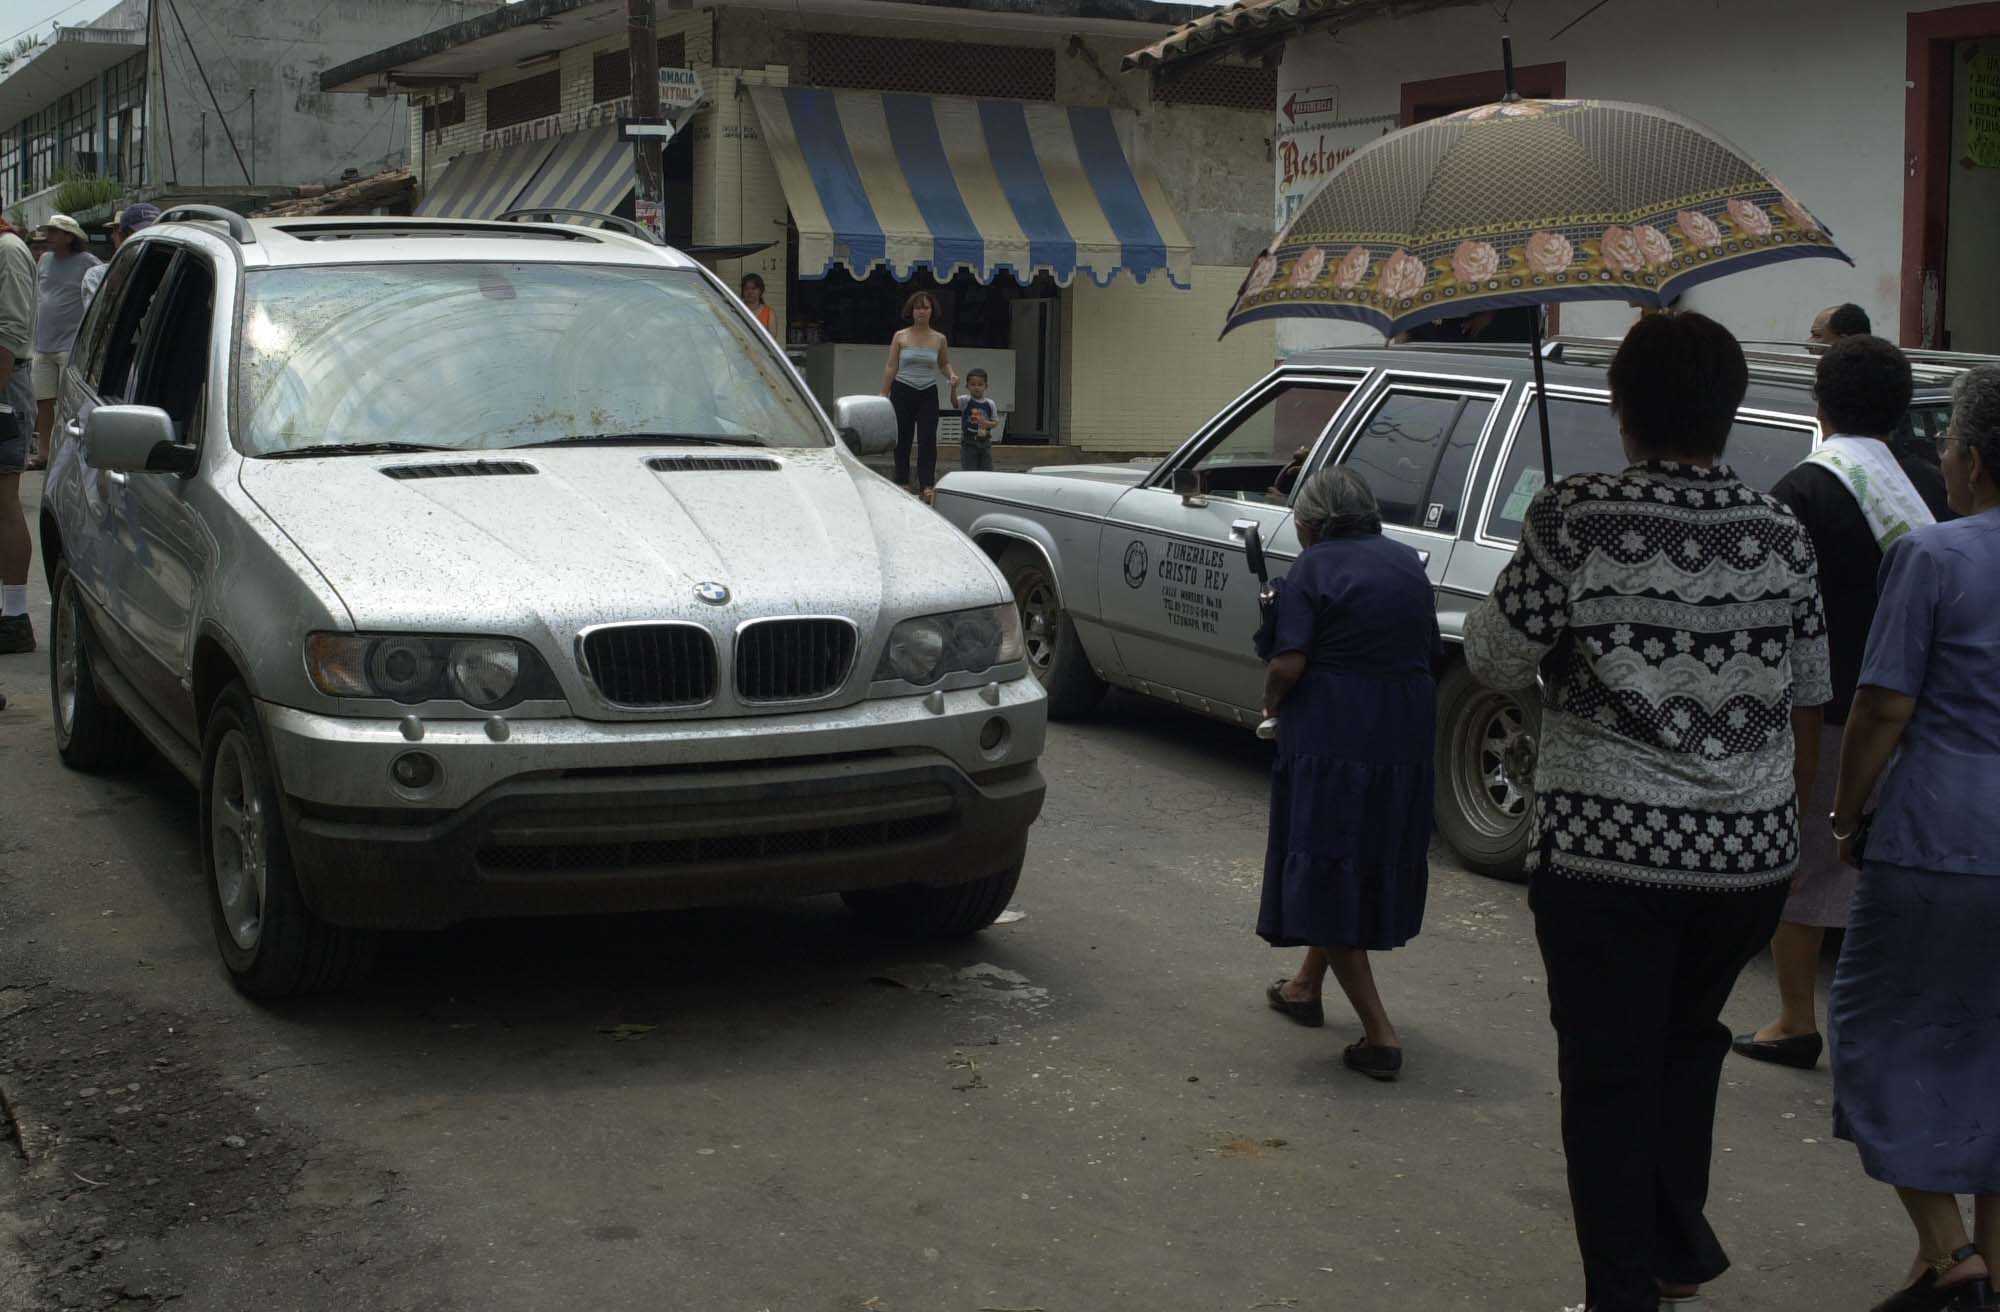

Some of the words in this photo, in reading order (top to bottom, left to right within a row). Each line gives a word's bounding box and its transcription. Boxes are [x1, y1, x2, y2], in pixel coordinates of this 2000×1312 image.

[656, 70, 695, 85] ARMACIA
[1166, 541, 1225, 568] FUNERALES
[1159, 560, 1197, 585] CRISTO
[1204, 568, 1229, 591] REY
